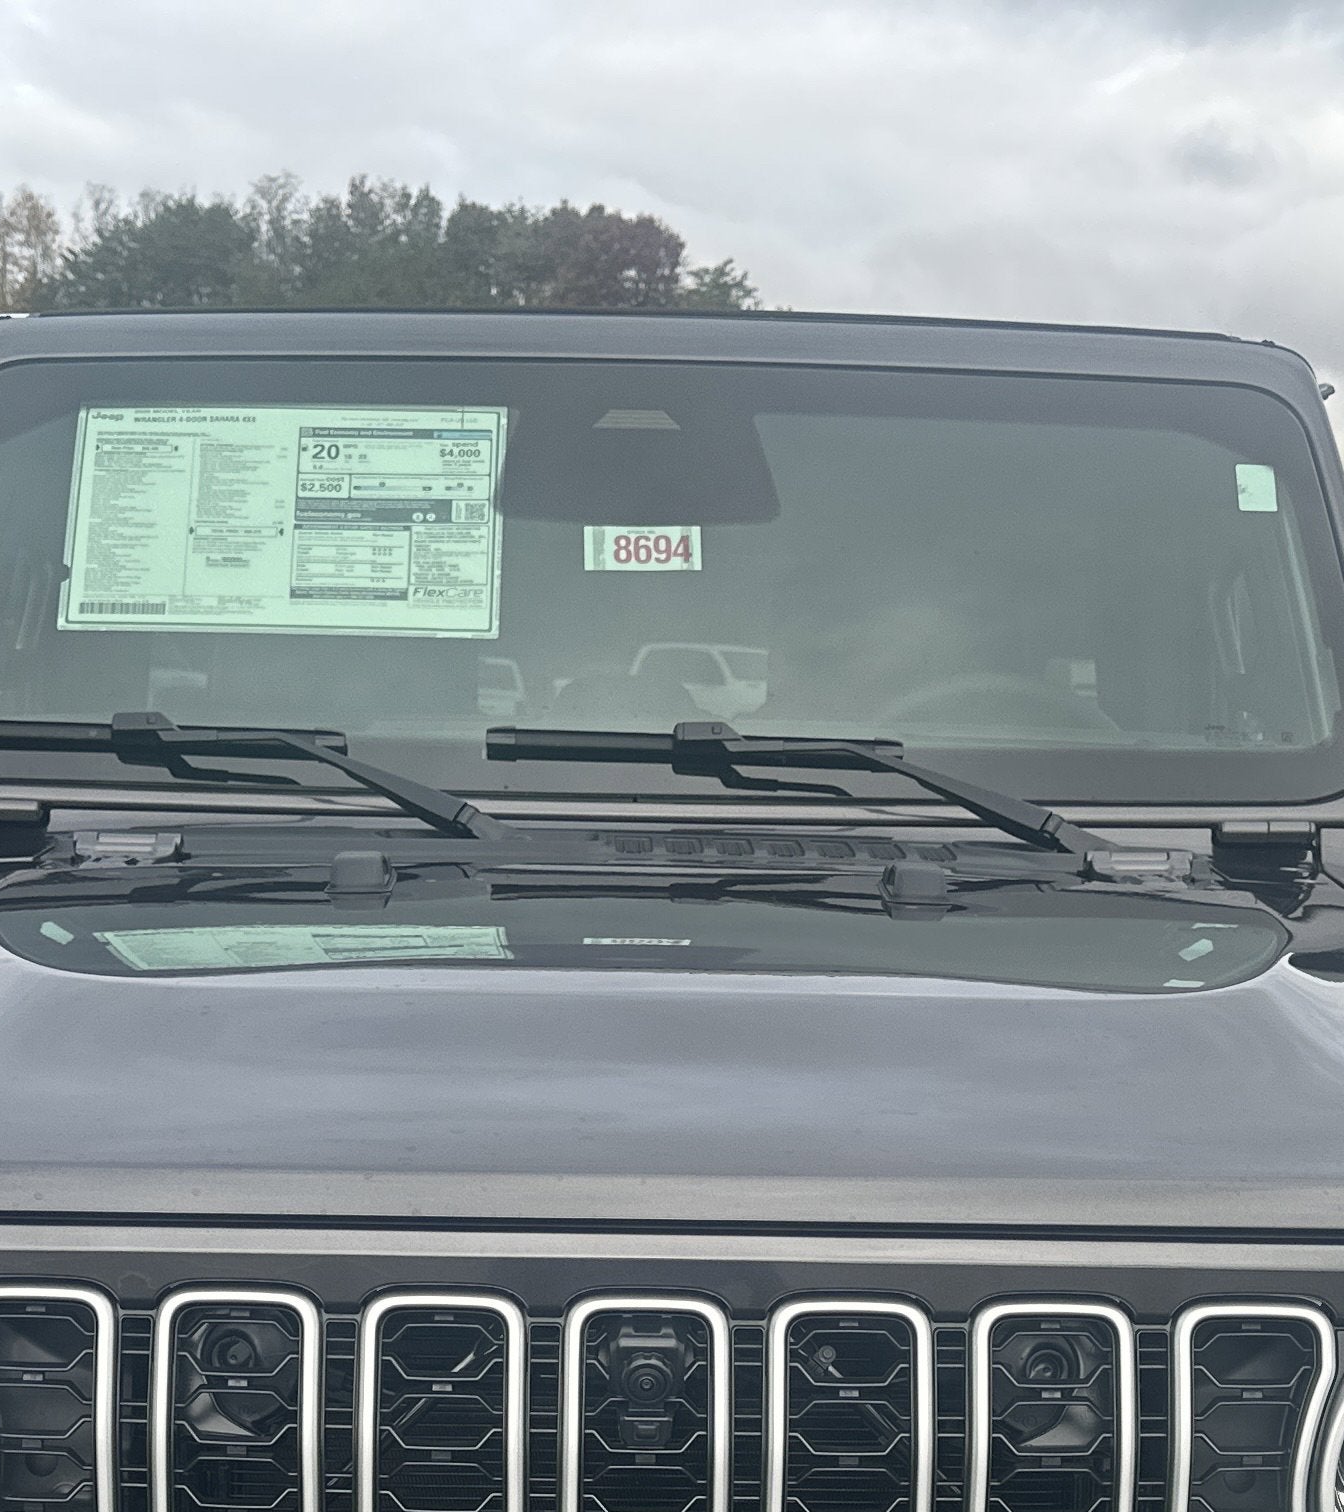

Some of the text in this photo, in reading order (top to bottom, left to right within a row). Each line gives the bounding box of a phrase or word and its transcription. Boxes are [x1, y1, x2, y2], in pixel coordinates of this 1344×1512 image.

[91, 411, 124, 422] Jeep
[312, 444, 340, 460] 20
[439, 448, 481, 459] $4,000
[300, 482, 342, 493] $2,500
[613, 534, 693, 565] 8694
[412, 586, 484, 598] FlexCare
